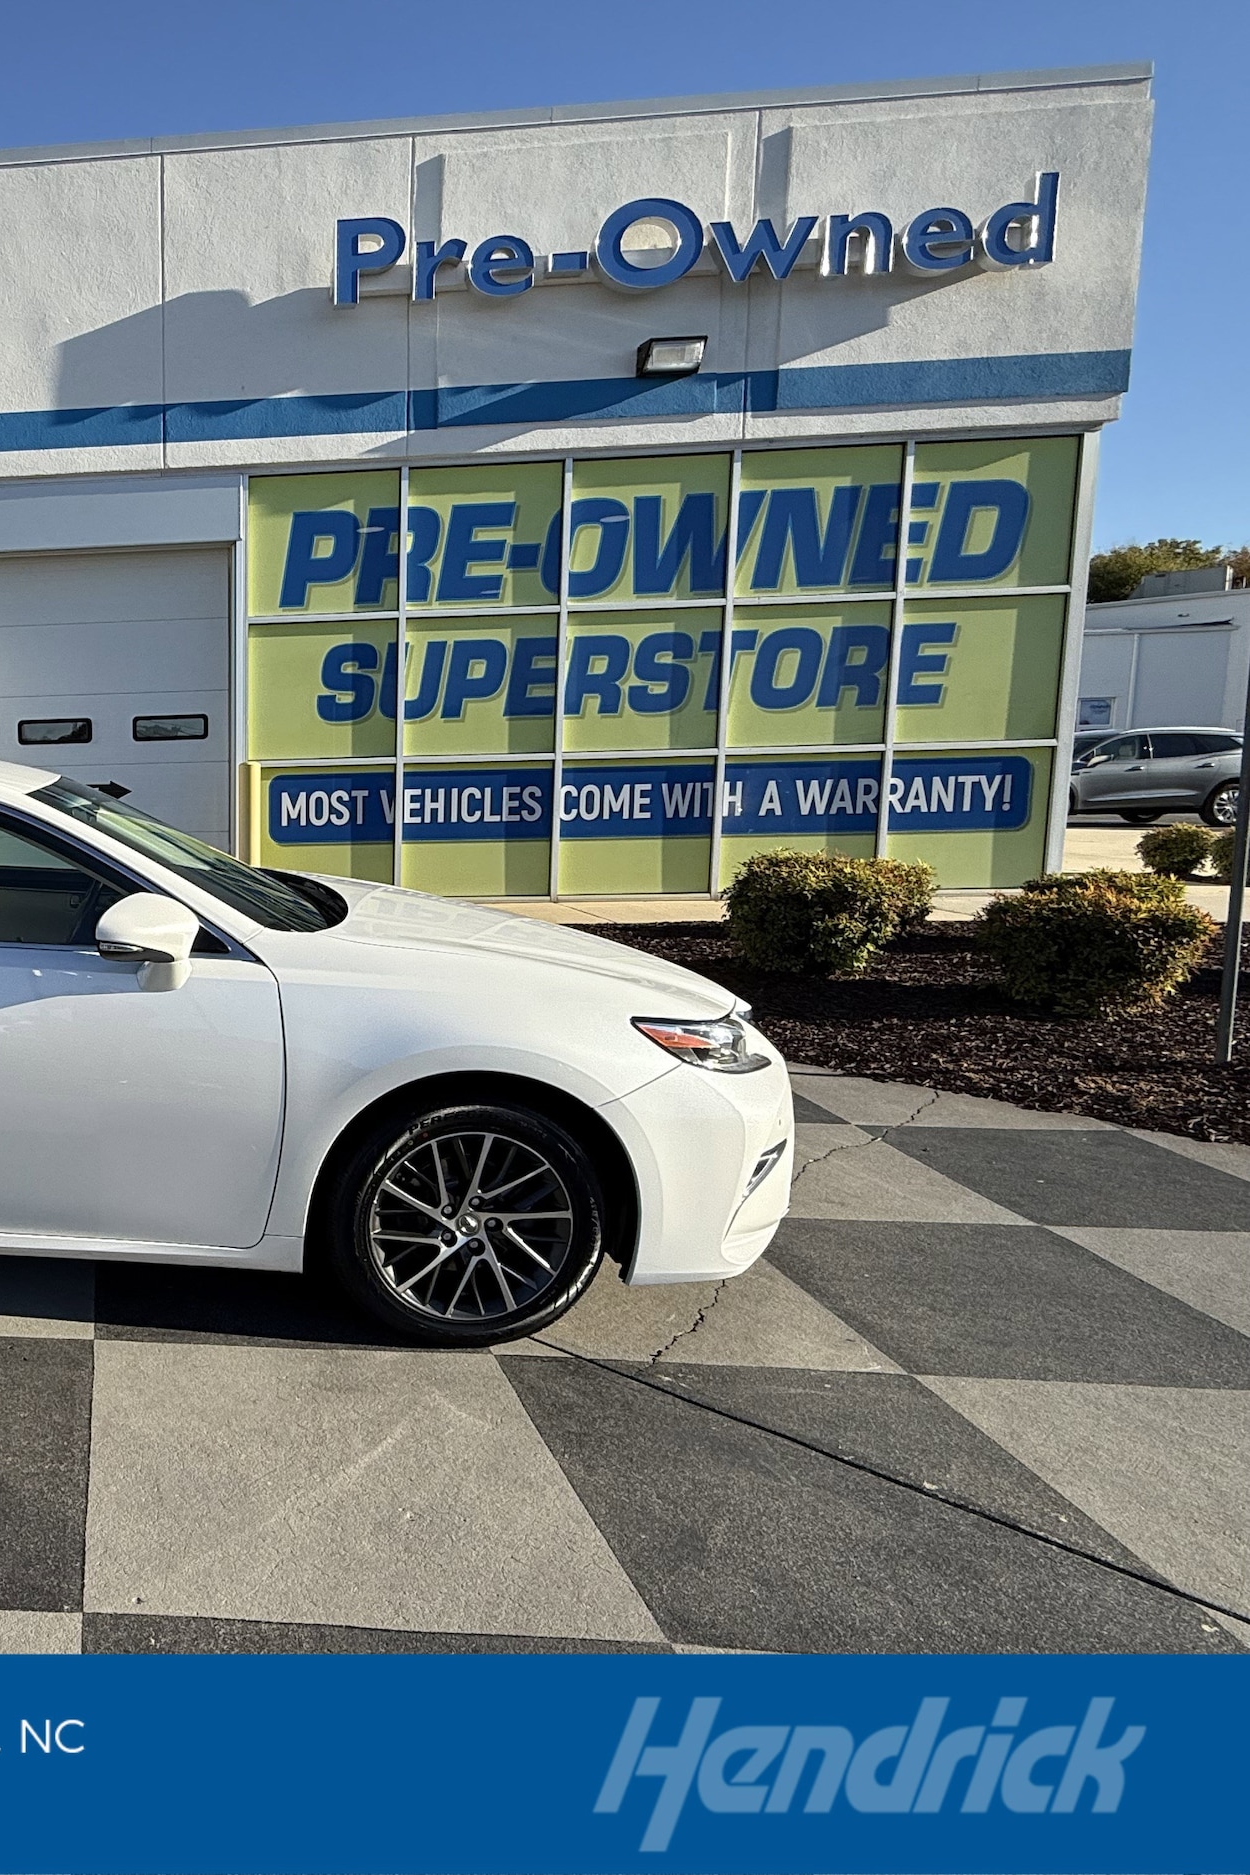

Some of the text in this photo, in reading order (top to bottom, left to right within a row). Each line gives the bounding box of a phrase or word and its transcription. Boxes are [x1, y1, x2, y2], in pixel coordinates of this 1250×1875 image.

[333, 170, 1061, 309] Pre-Owned
[279, 478, 1032, 608] PRE-OWNED
[316, 621, 957, 723] SUPERSTORE
[280, 774, 1014, 827] MOST VEHICLES COME WITH A WARRANTY!
